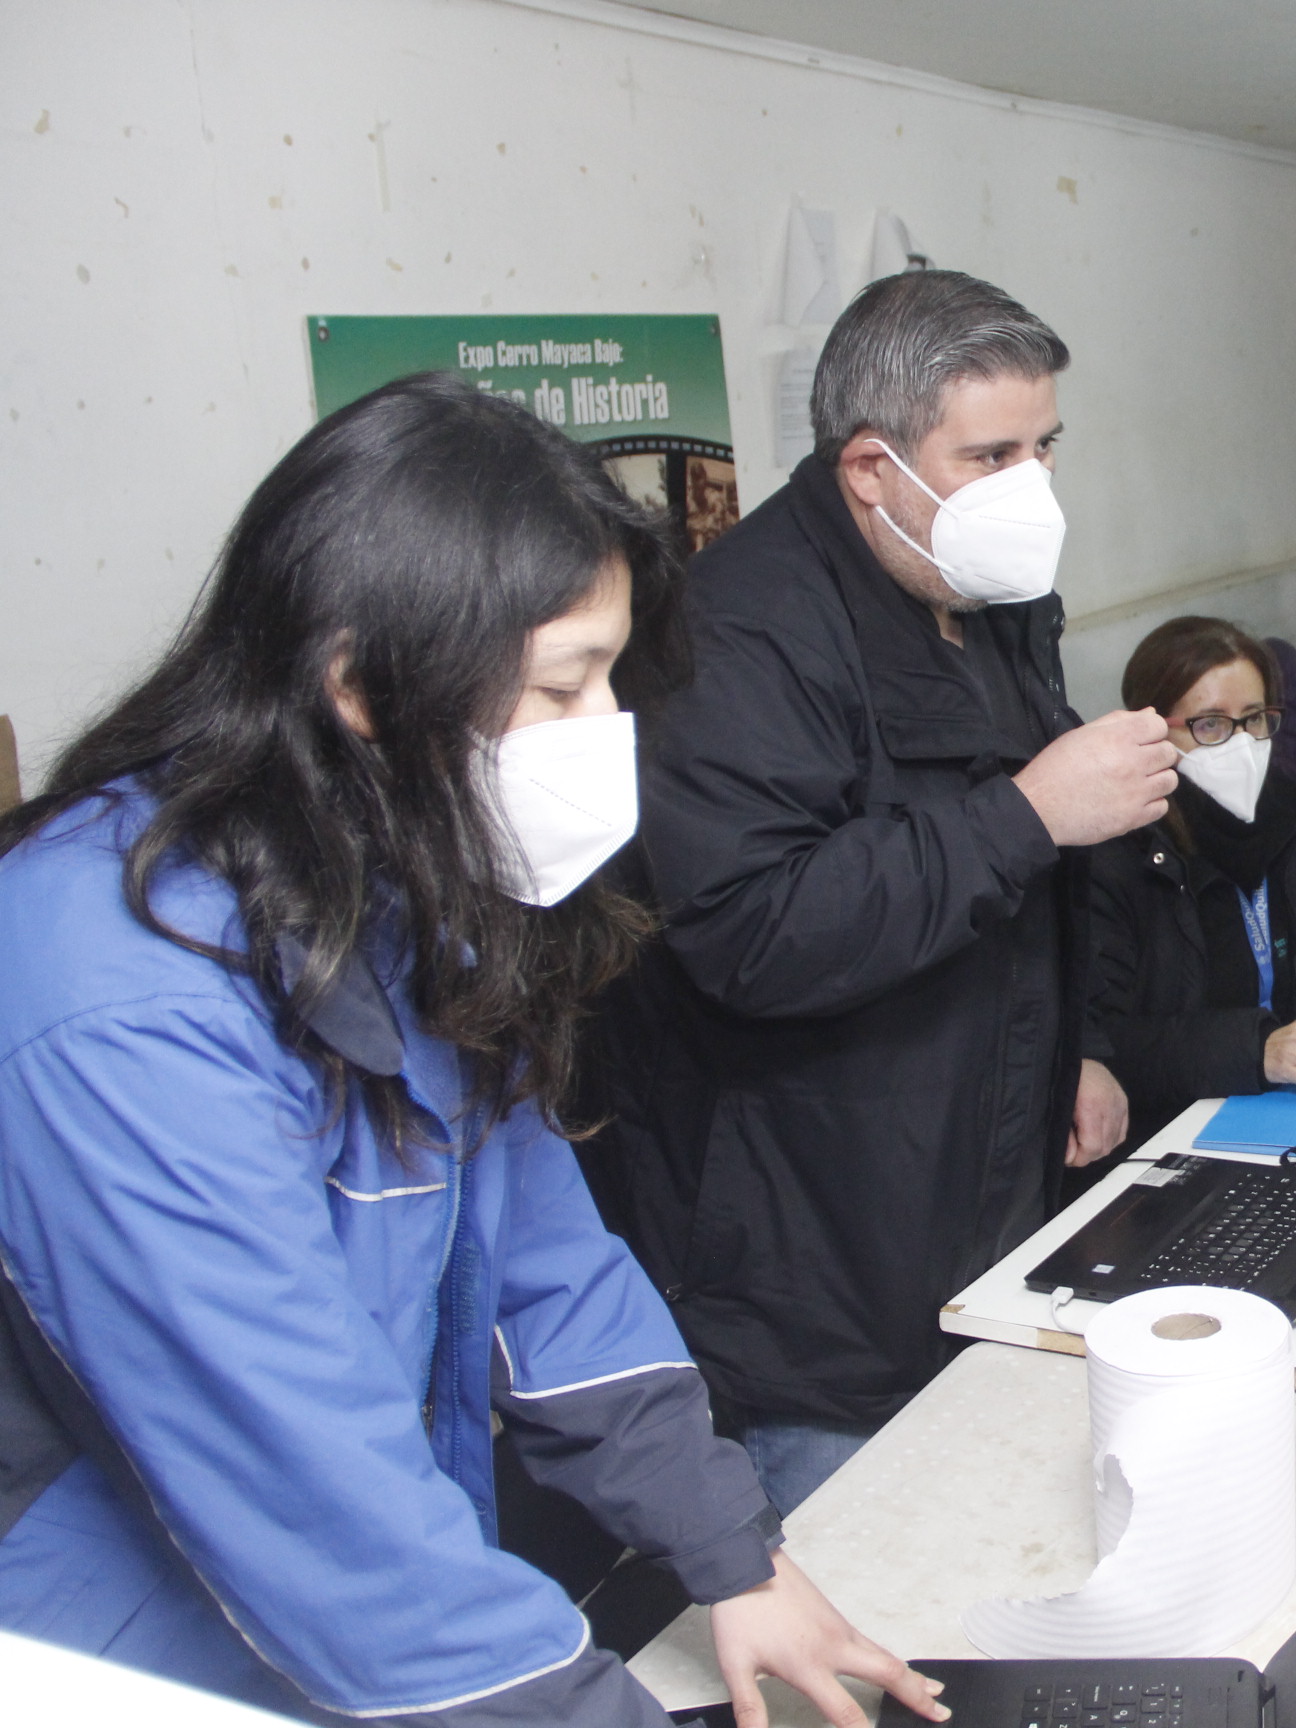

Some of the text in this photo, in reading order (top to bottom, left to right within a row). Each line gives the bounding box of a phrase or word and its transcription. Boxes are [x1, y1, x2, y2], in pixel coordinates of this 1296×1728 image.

[458, 341, 494, 371] Expo
[497, 340, 539, 367] Cerro
[541, 339, 592, 369] Mayaca
[534, 378, 566, 425] de
[571, 374, 669, 425] Historia
